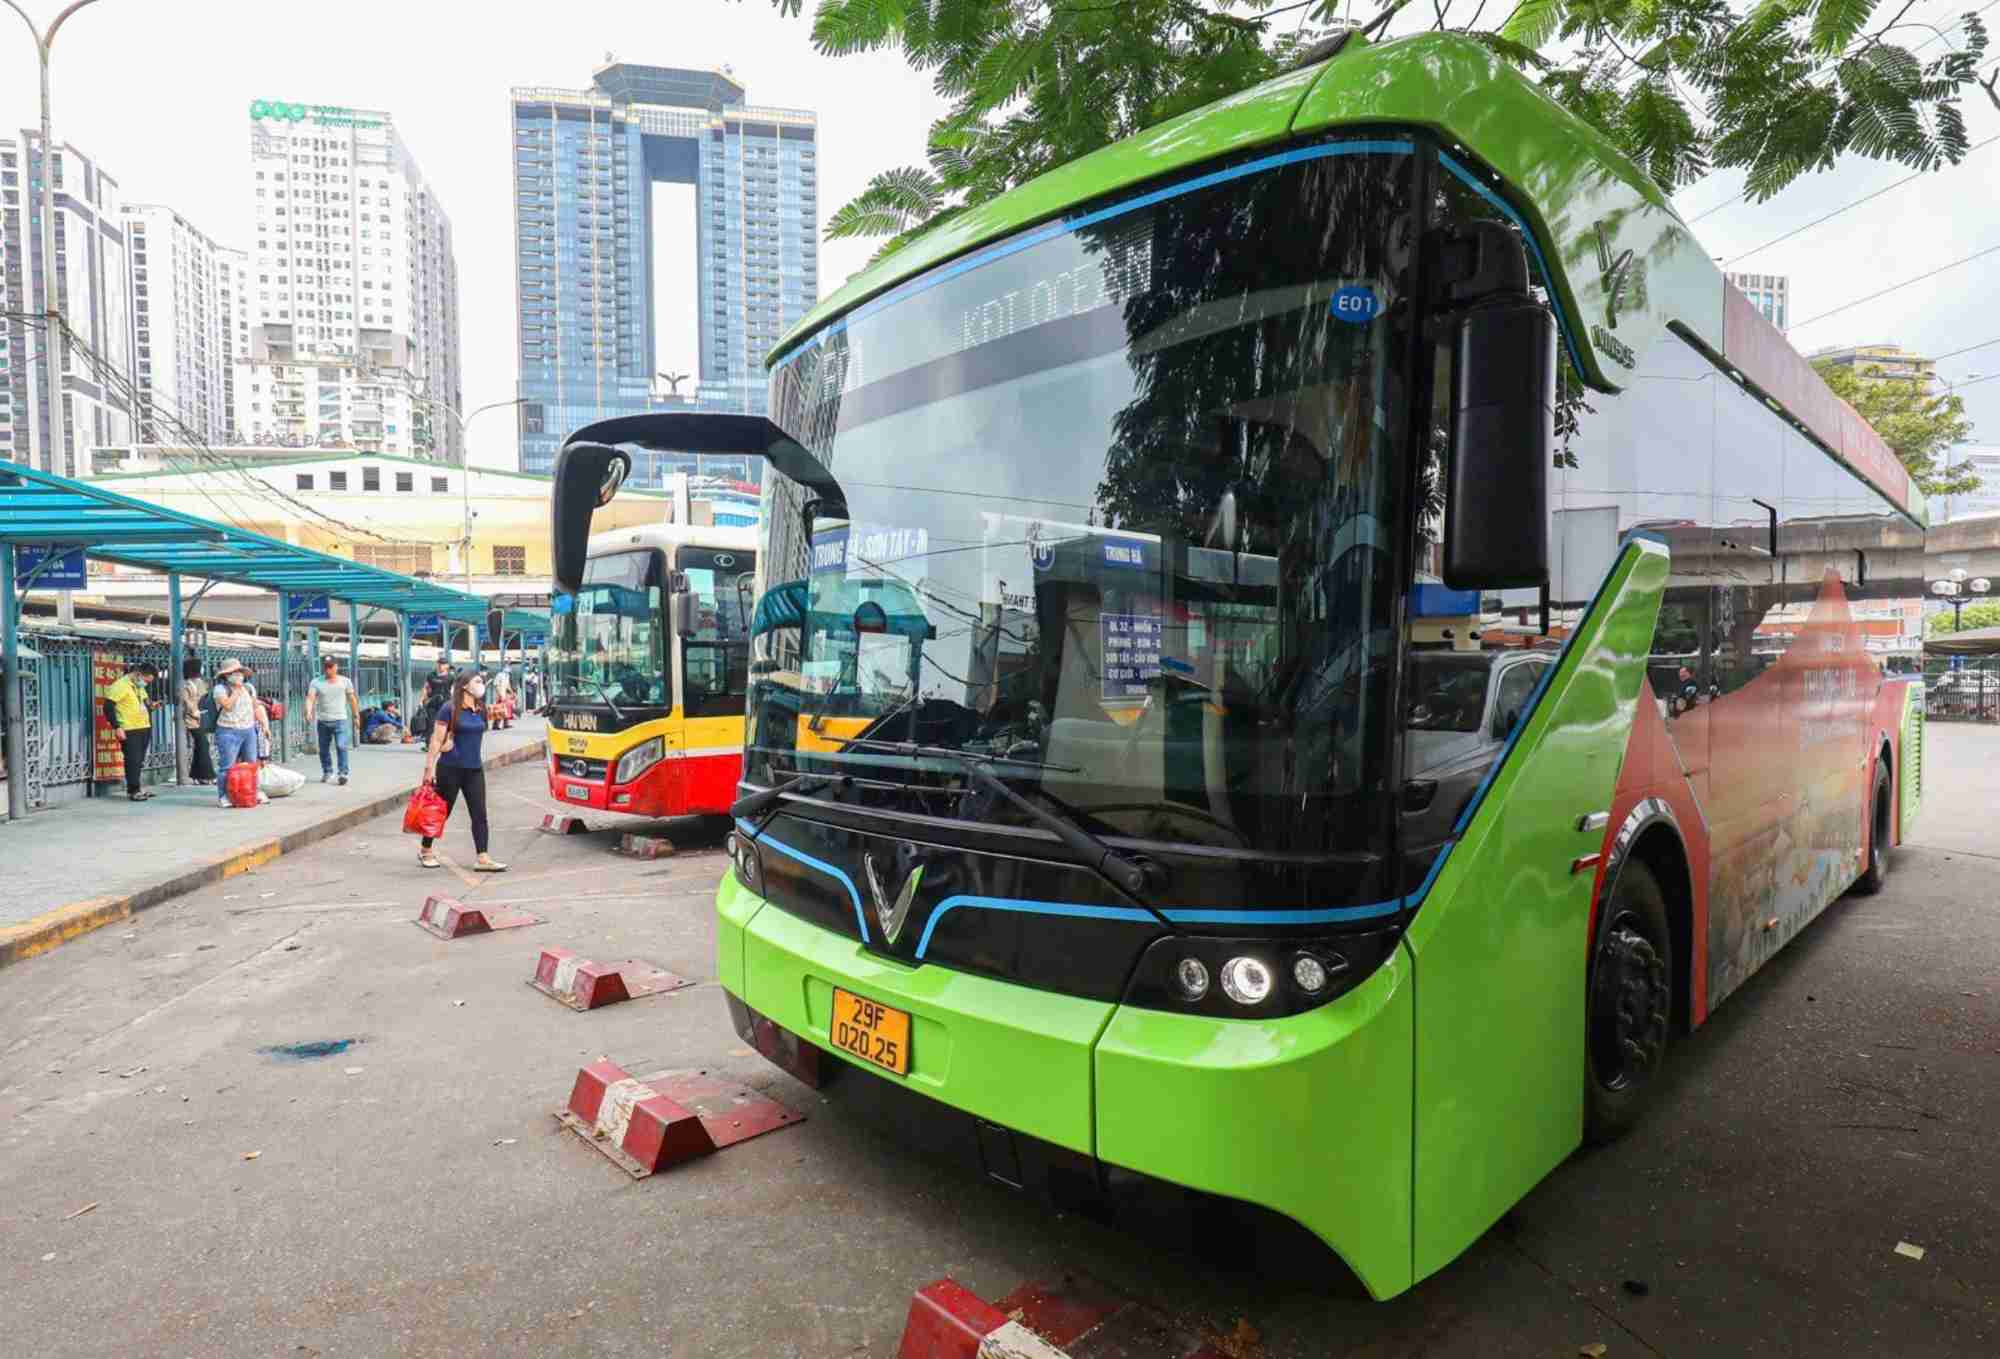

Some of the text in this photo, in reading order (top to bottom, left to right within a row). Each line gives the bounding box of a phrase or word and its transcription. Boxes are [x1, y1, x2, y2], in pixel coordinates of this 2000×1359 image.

[1339, 296, 1372, 312] E01
[852, 998, 886, 1030] 29F
[838, 1022, 898, 1068] 020.25
